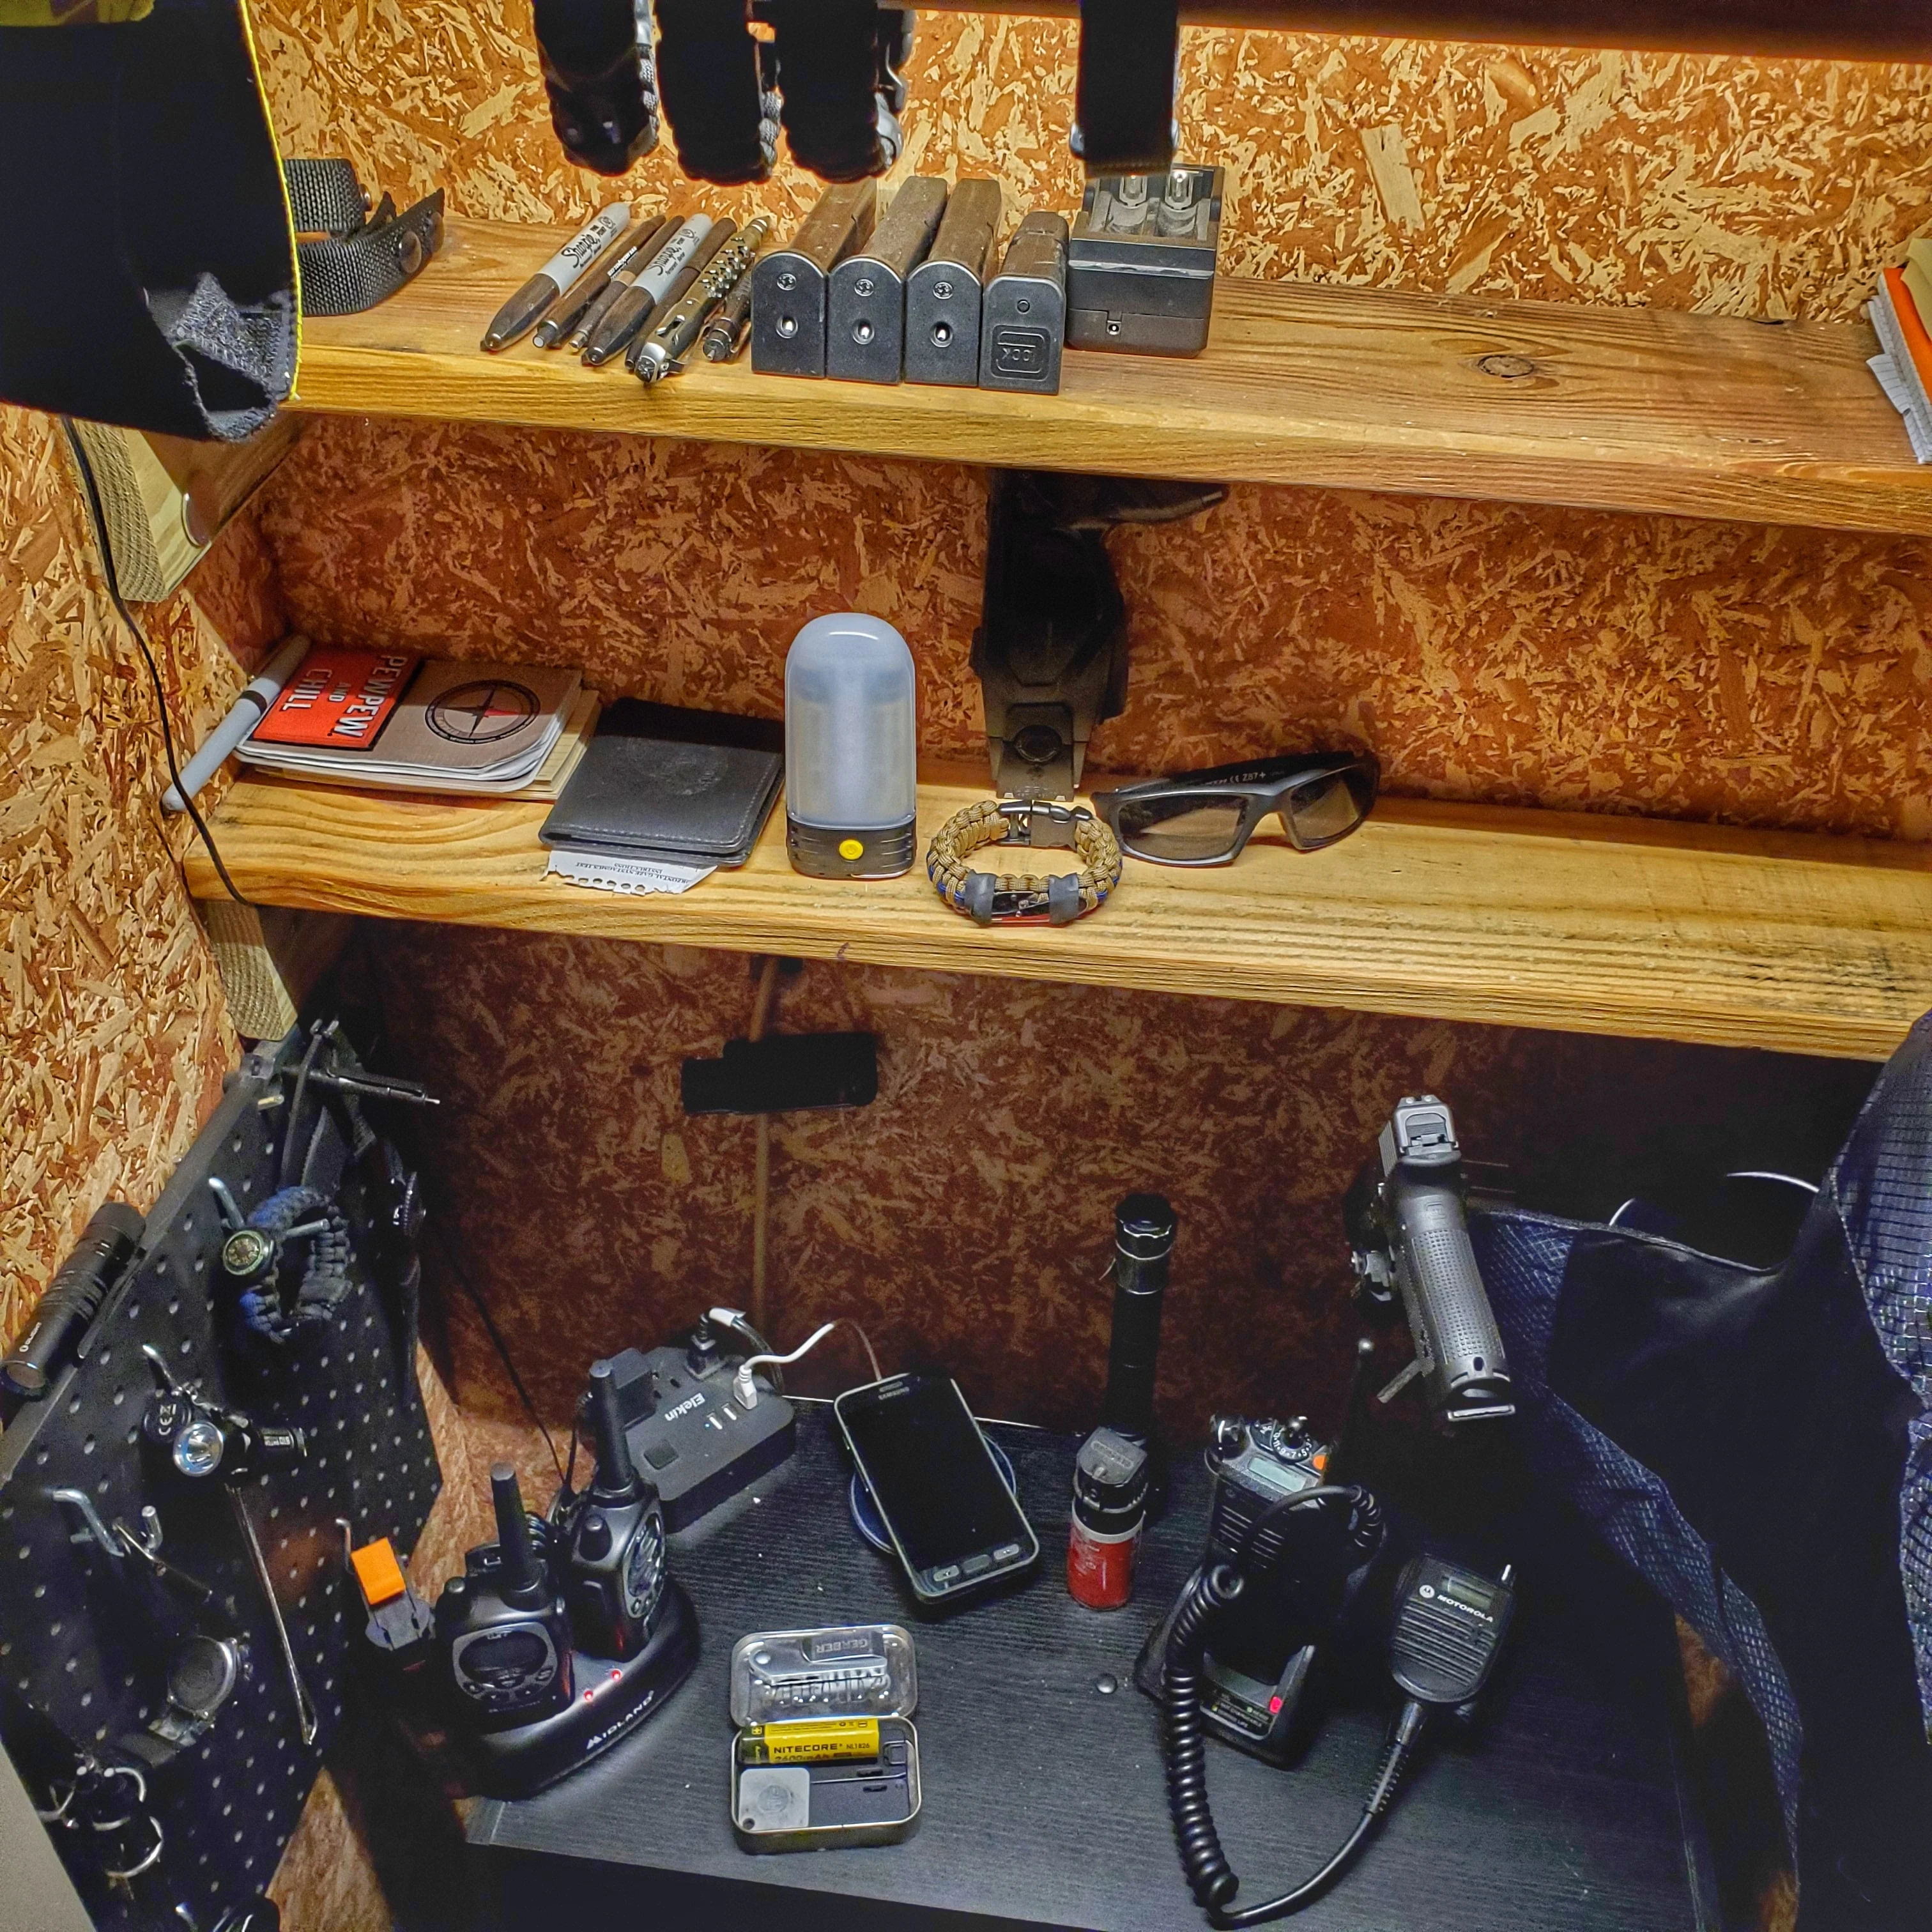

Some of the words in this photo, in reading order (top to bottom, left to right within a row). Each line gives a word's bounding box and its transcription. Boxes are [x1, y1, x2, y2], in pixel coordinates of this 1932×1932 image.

[561, 234, 598, 268] Sharpie
[282, 668, 334, 711] CHILL
[328, 681, 351, 702] AND
[614, 862, 664, 875] INSTRUCTIONS
[664, 1392, 706, 1422] Elekin
[1437, 1594, 1494, 1623] MOTOROLA
[815, 1639, 870, 1654] GERBER
[586, 1690, 655, 1750] MIDLAND
[773, 1743, 839, 1754] NITECORE
